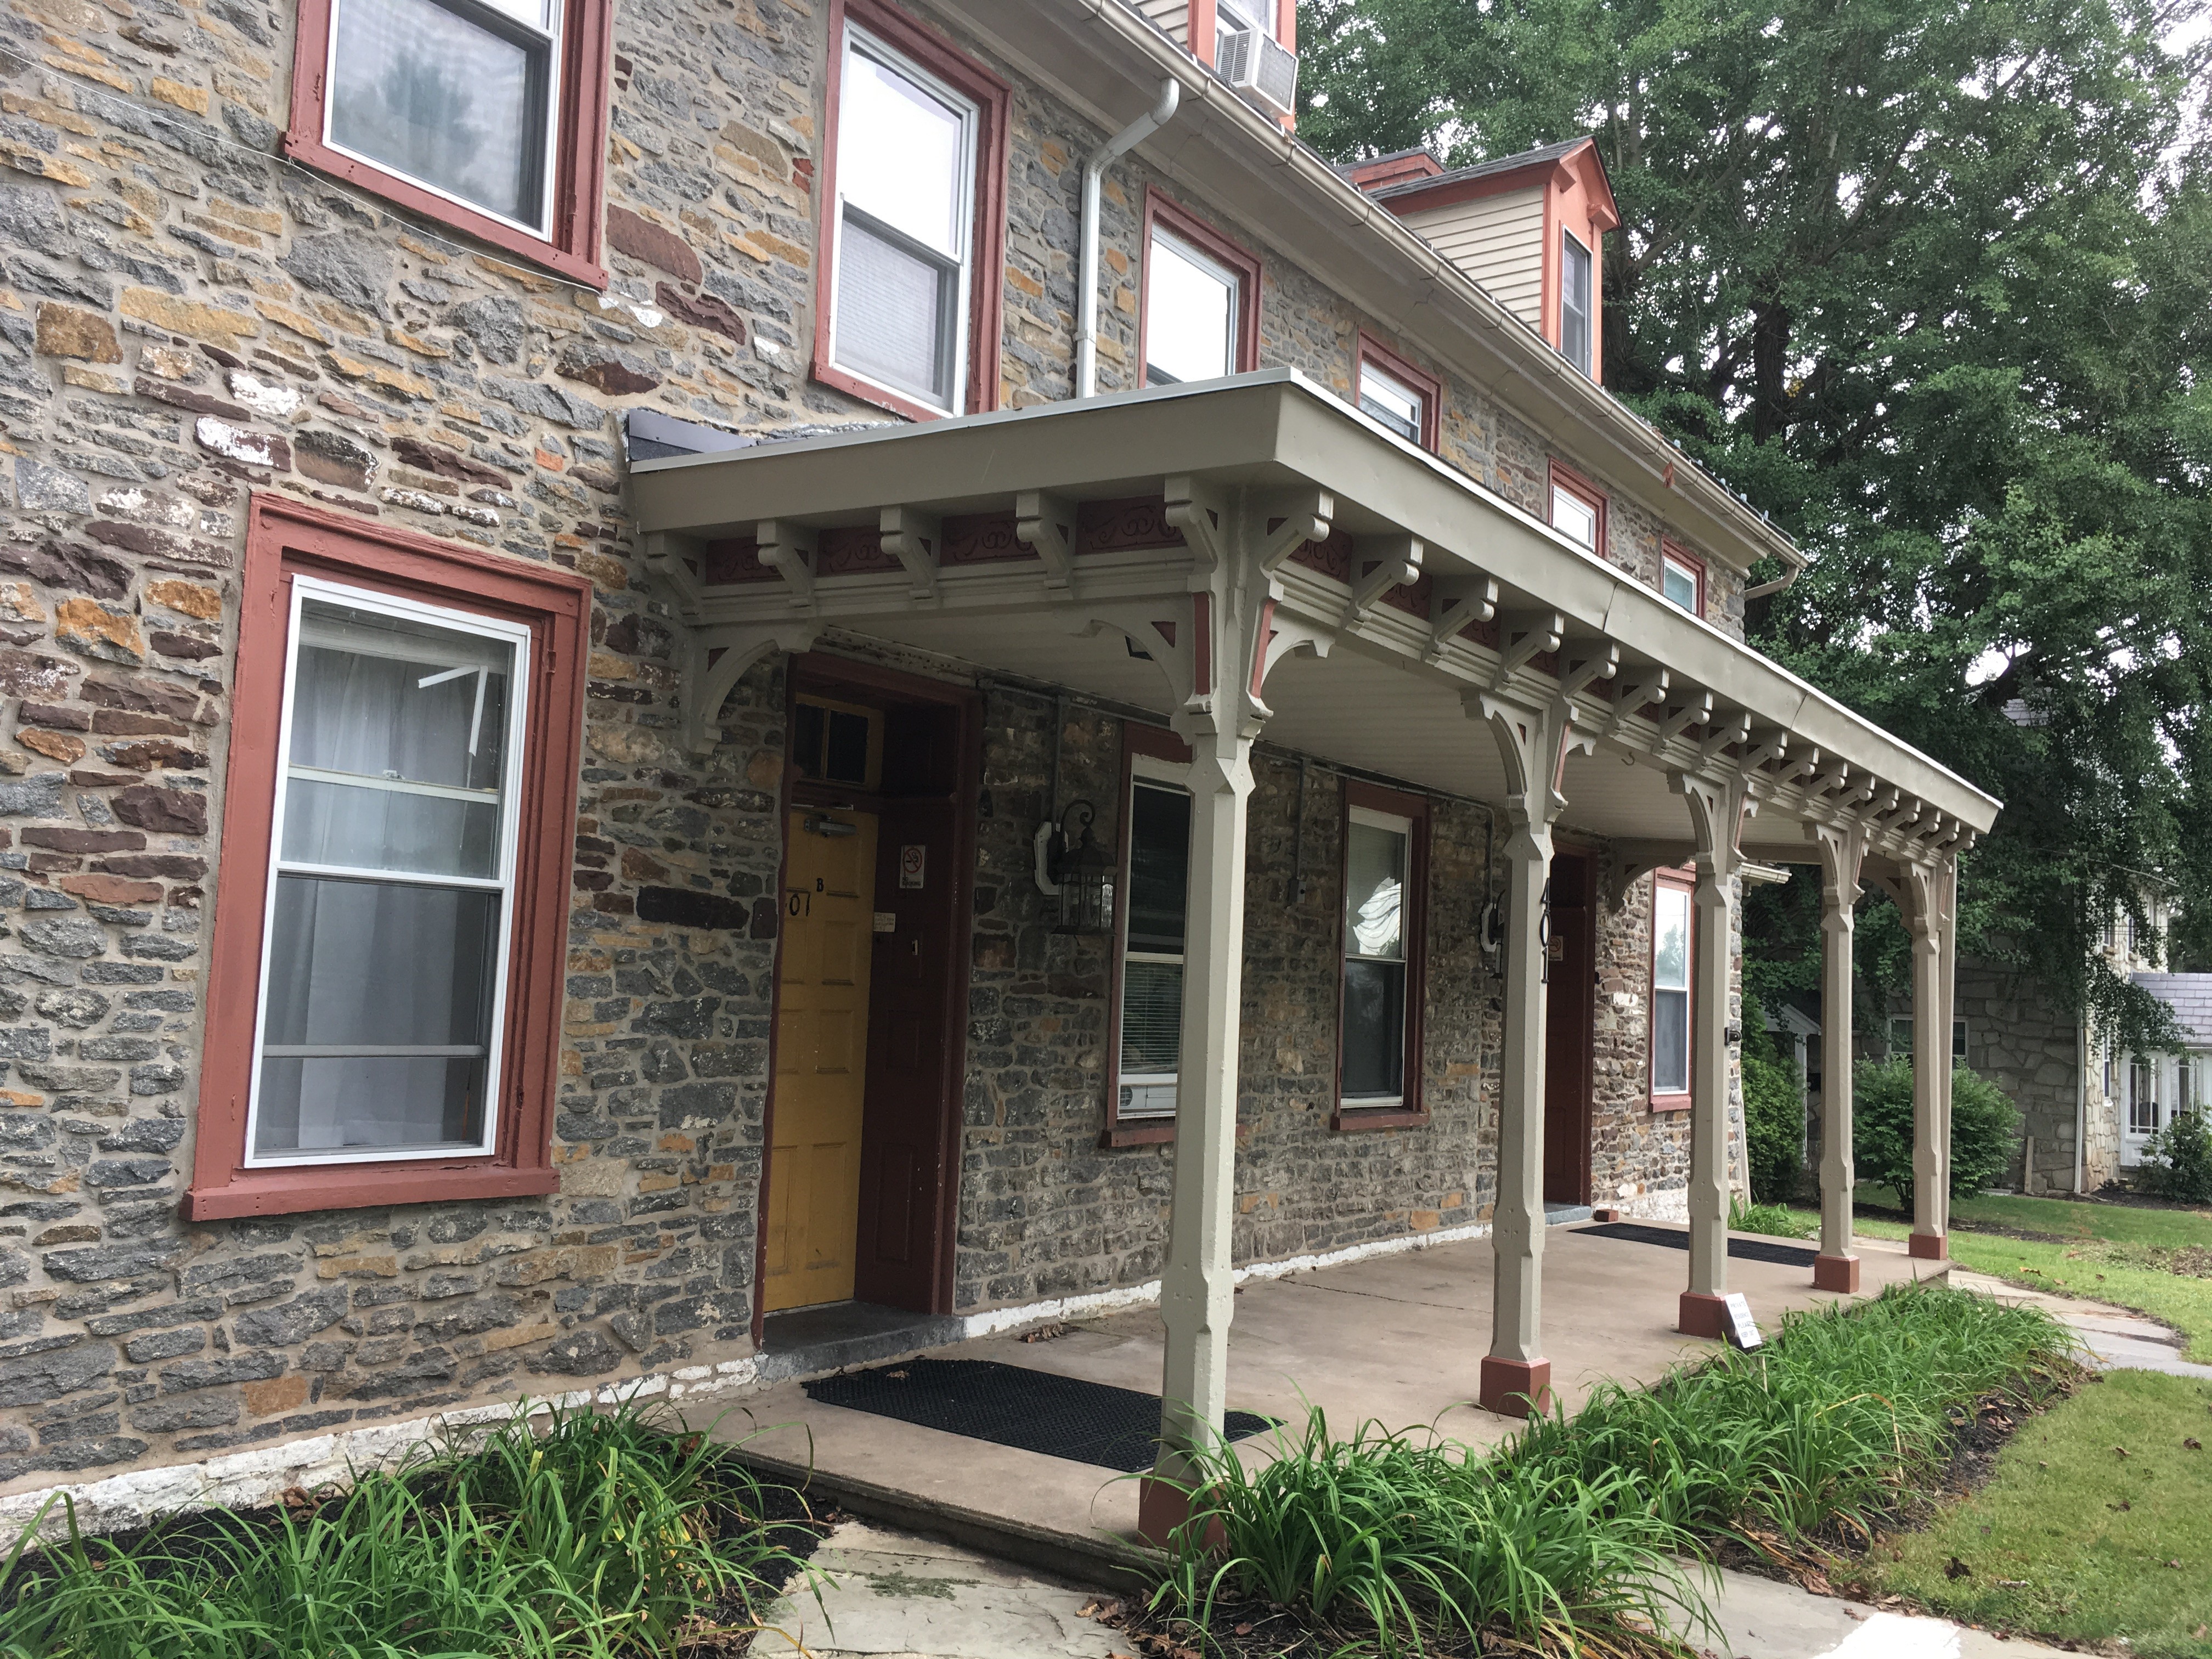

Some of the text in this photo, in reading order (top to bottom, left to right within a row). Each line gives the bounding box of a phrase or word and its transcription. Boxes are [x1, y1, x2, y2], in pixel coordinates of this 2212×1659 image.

[816, 878, 824, 892] B
[786, 893, 811, 917] 01
[1539, 877, 1551, 984] 401
